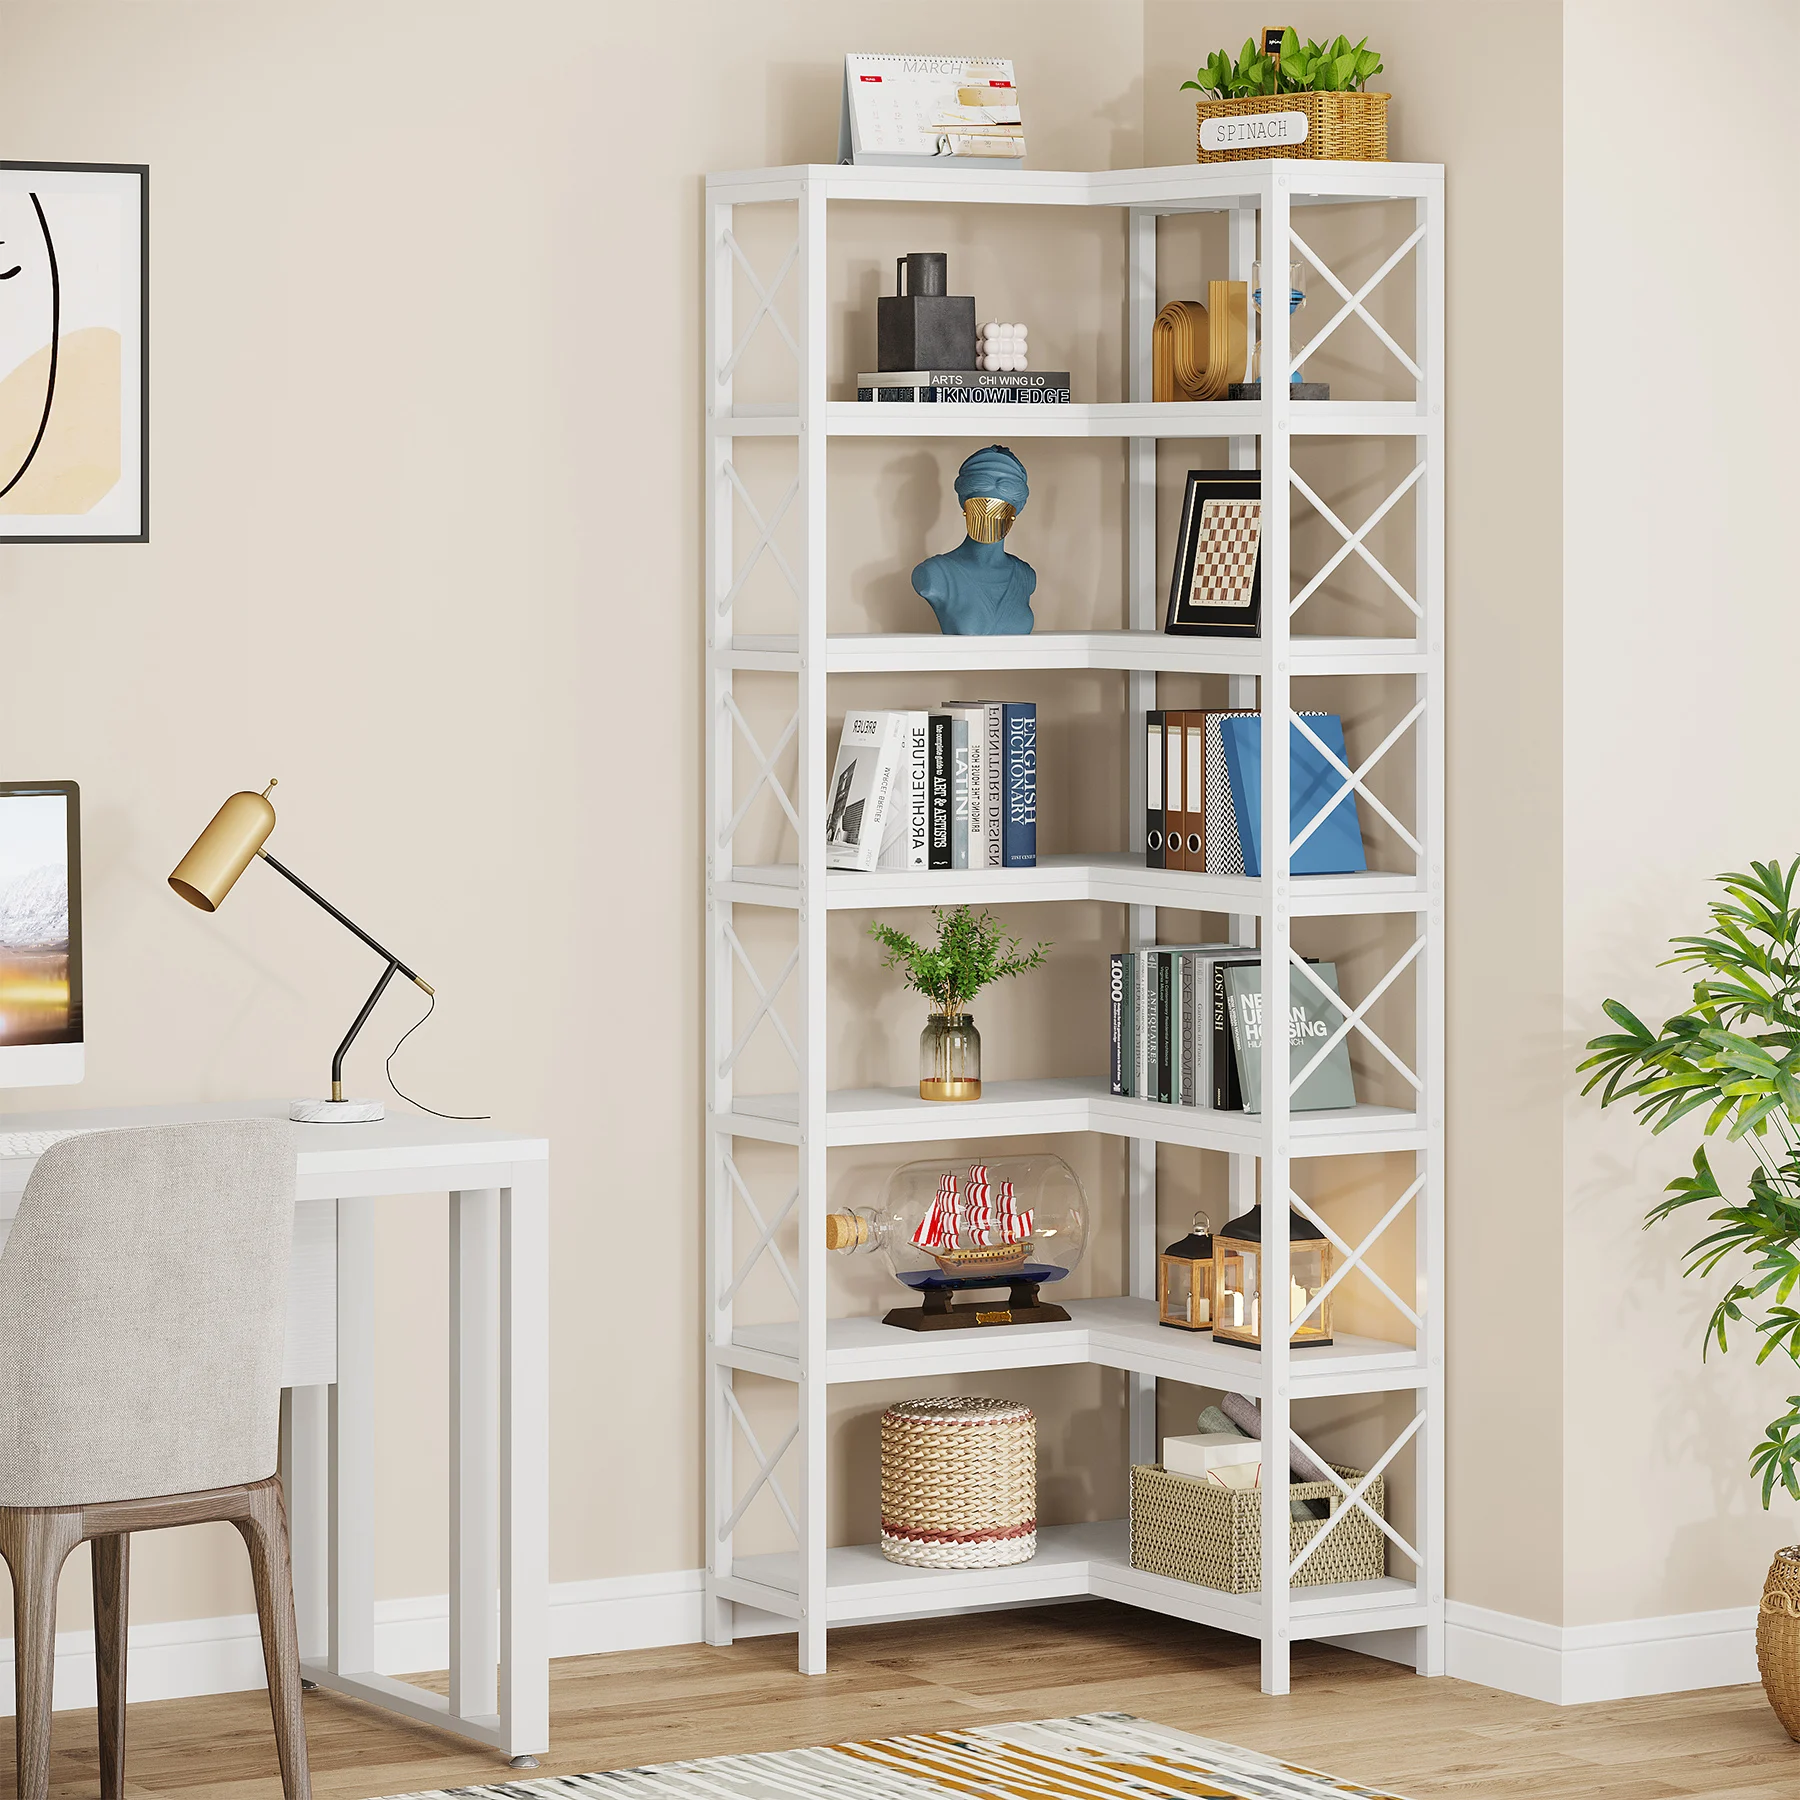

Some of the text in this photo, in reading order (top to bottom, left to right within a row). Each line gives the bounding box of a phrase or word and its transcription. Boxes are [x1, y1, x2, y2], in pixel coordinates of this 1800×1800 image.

[903, 62, 962, 74] MARCH
[1217, 120, 1288, 142] SPINACH
[931, 376, 963, 385] ARTS
[979, 376, 1045, 386] CHI WING LO
[945, 388, 1069, 403] KNOWLEDGE
[956, 748, 968, 815] LATIN
[1011, 718, 1024, 825] DICTIONARY
[1024, 718, 1036, 825] ENGLISH
[934, 777, 947, 796] ART
[934, 798, 947, 806] &
[934, 808, 947, 848] ARTISTS
[1112, 960, 1122, 1002] 1000
[1215, 966, 1224, 1031] LOST FISH
[1241, 994, 1261, 1009] NE
[1183, 956, 1192, 1097] ALEXEY BRODOVITCH
[1245, 1021, 1327, 1040] HSING
